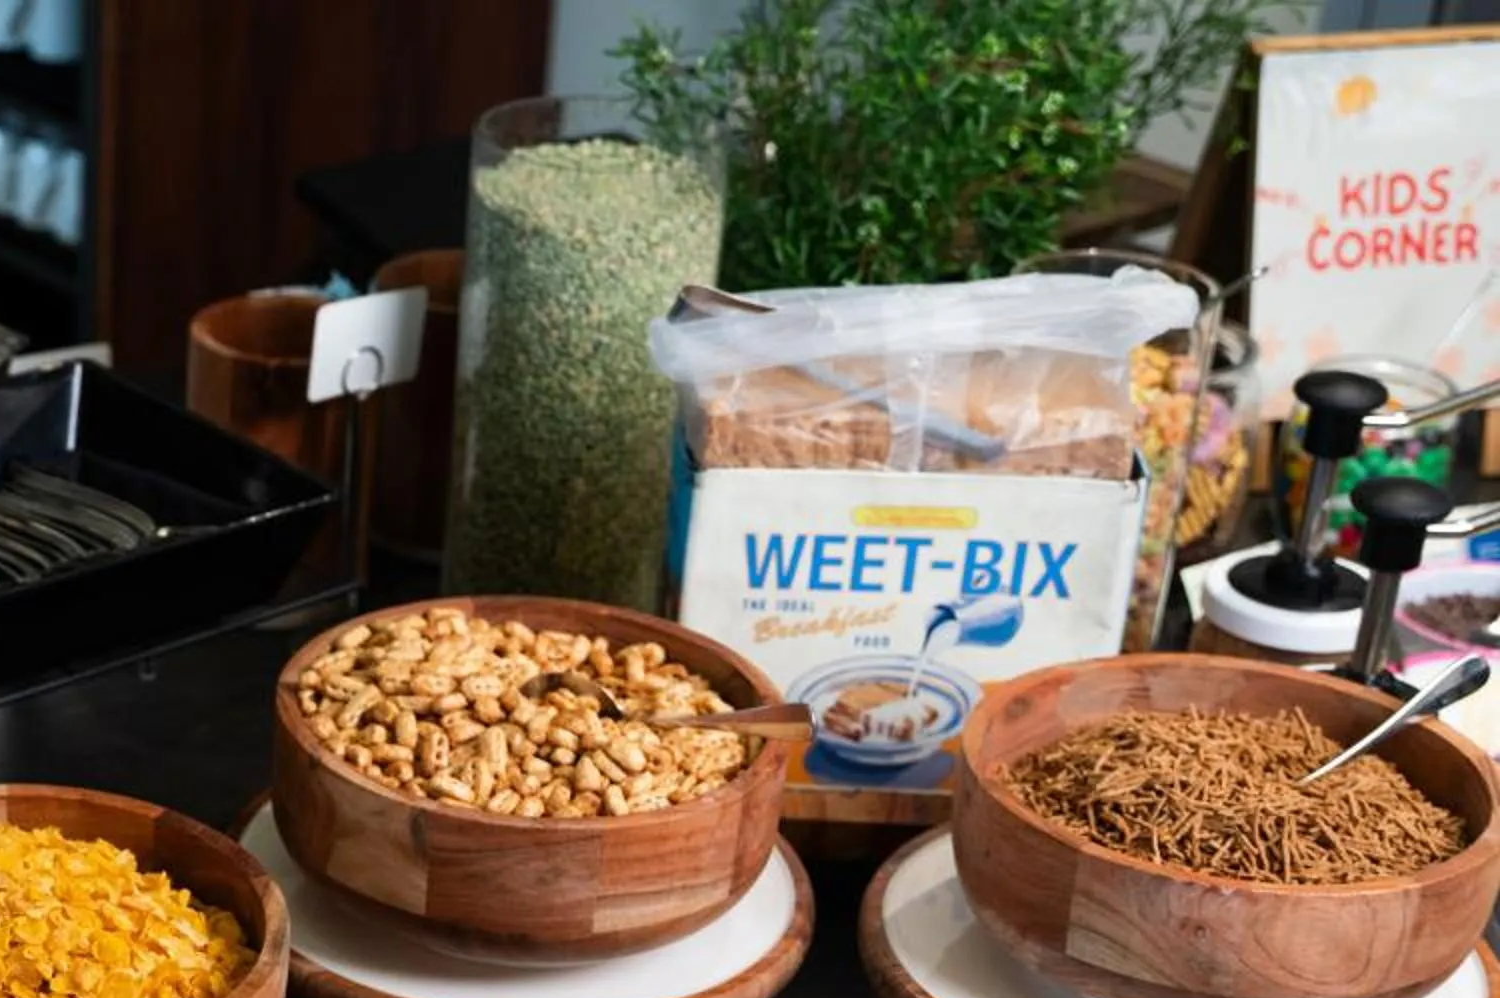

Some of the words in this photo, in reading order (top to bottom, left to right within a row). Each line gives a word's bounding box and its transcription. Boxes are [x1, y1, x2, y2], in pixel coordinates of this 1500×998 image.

[1339, 166, 1452, 218] KIDS
[1306, 220, 1480, 272] CORNER
[745, 532, 1078, 600] WEET-BIX
